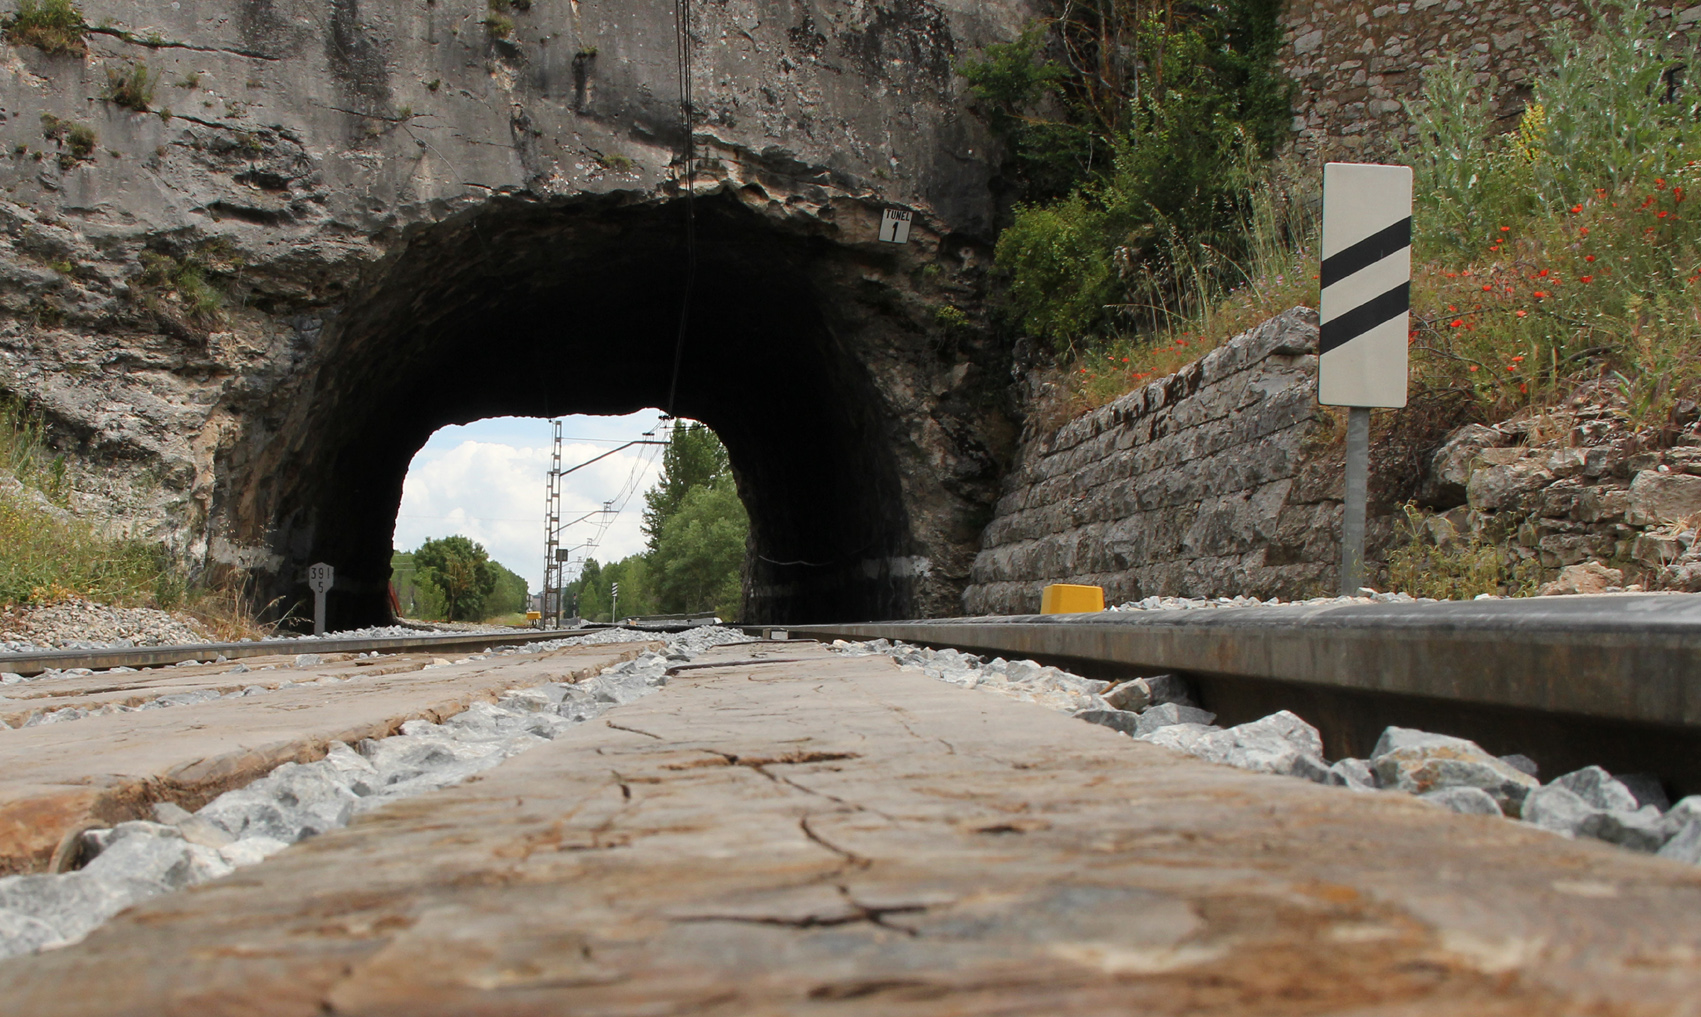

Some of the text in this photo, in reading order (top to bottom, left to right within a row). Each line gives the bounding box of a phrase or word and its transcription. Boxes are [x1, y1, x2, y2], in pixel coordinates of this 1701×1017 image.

[886, 209, 910, 221] TUNEL
[892, 221, 899, 241] 1
[311, 567, 330, 580] 391
[318, 581, 324, 594] 5
